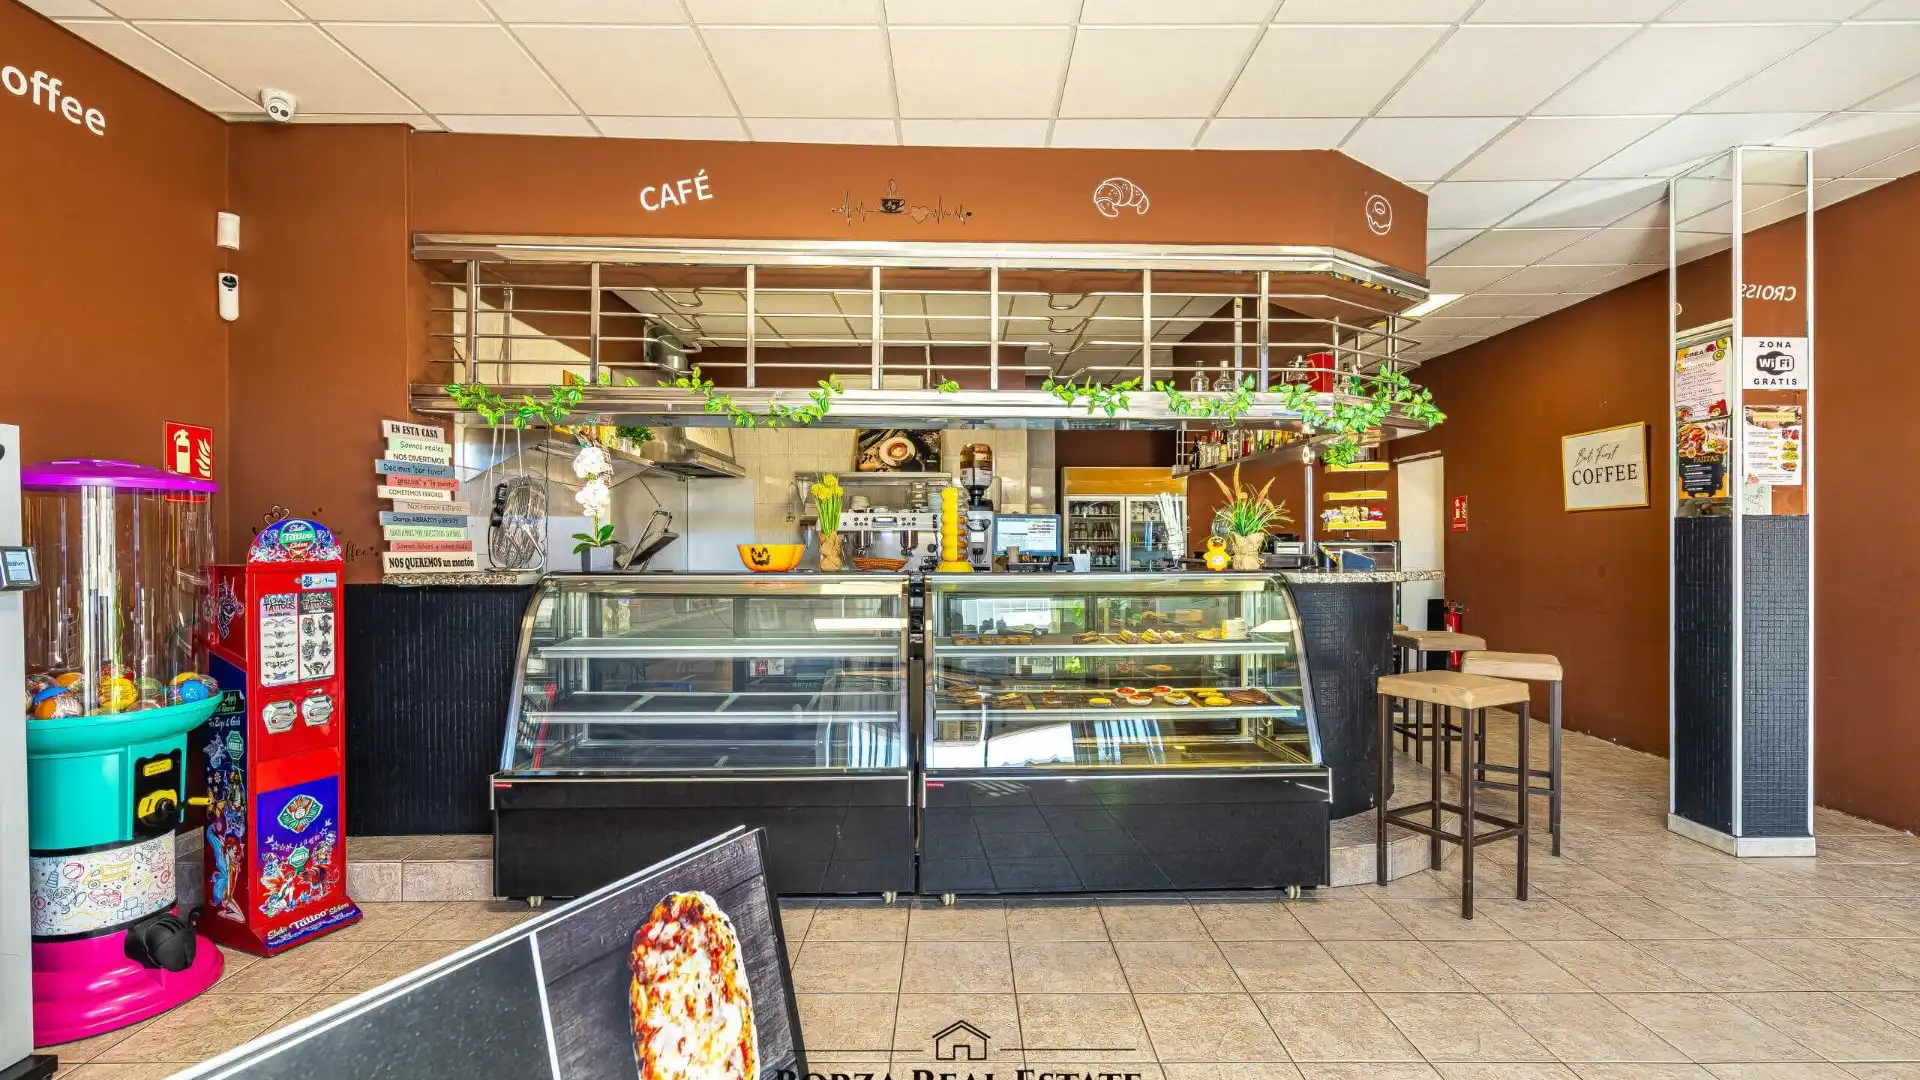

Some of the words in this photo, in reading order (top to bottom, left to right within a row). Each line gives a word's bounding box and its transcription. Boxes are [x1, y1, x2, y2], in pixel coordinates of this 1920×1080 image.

[640, 168, 714, 211] CAFÉ
[391, 424, 401, 433] EN
[402, 426, 420, 436] ESTA
[422, 428, 438, 438] CASA
[400, 440, 422, 450] Somos
[425, 444, 444, 452] reales
[408, 455, 444, 464] DIVERTIMOS
[384, 463, 410, 472] Decimos
[1572, 464, 1638, 486] COFFEE
[388, 488, 420, 497] COMETEMOS
[389, 558, 404, 568] NOS
[405, 558, 442, 570] QUEREMOS
[289, 909, 328, 930] Tattoo
